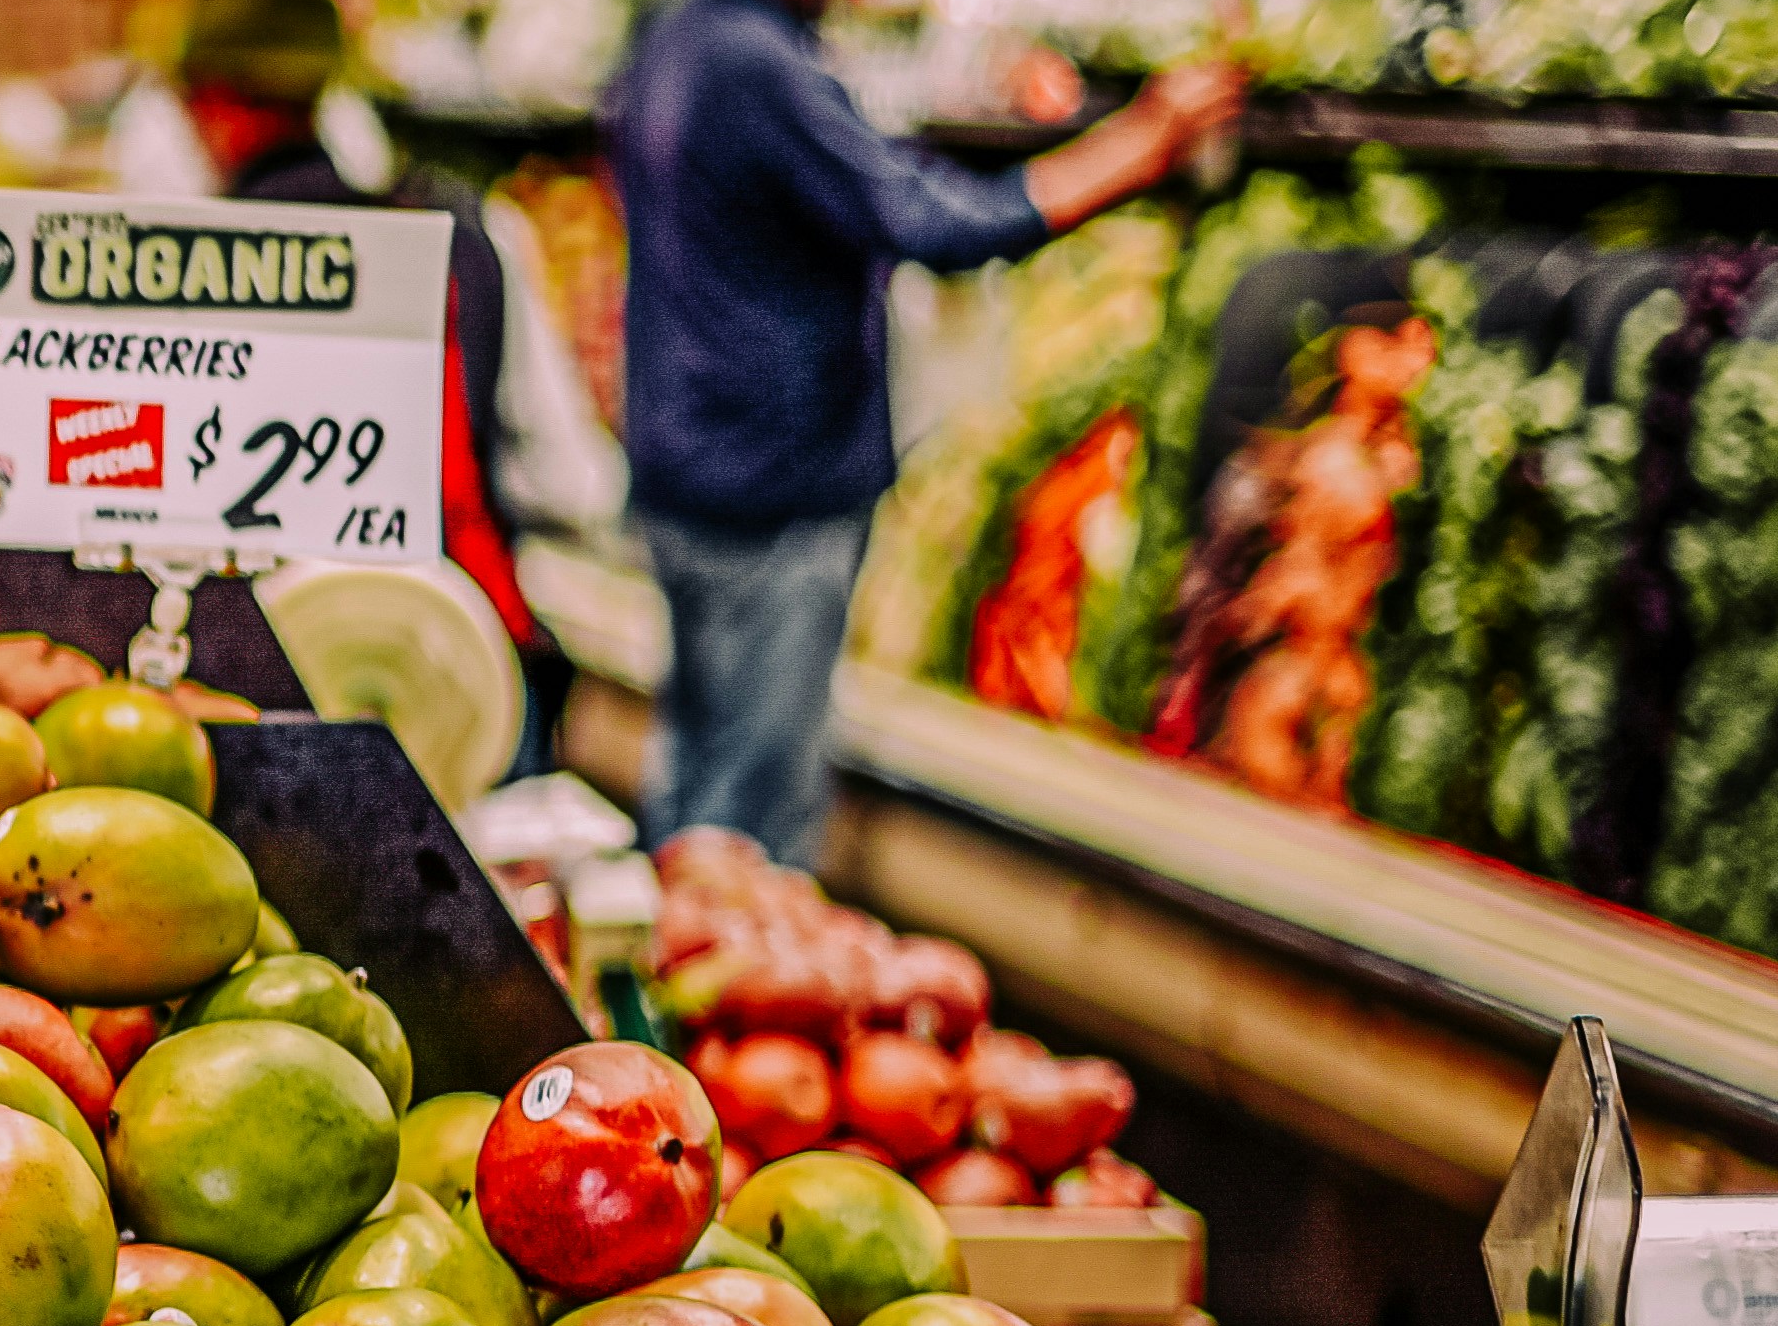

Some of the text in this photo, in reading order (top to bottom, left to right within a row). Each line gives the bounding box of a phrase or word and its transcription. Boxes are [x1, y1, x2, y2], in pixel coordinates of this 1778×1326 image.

[40, 233, 352, 304] ORGANIC
[56, 401, 140, 445] WEEKLY
[66, 440, 156, 487] SPECIAL
[335, 505, 407, 548] /EA
